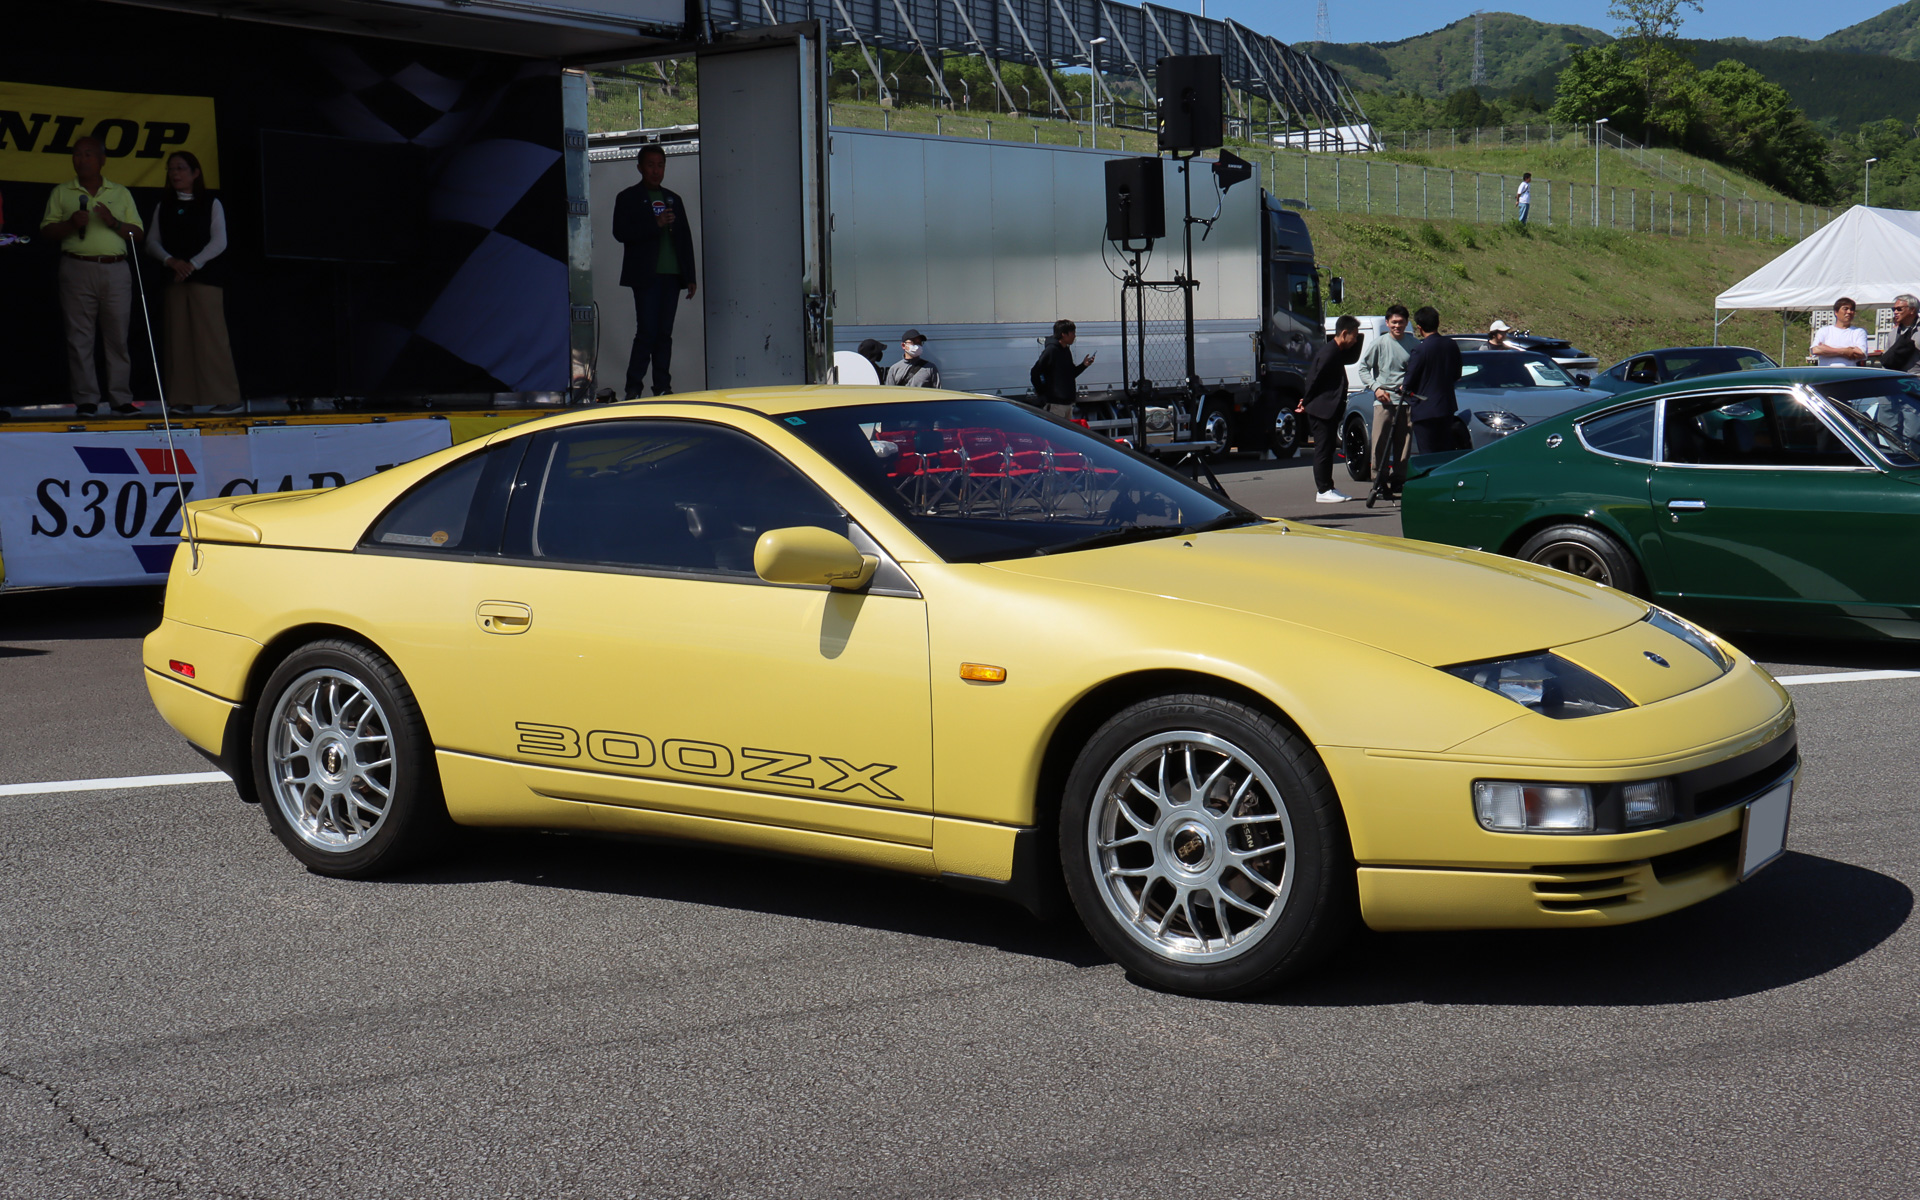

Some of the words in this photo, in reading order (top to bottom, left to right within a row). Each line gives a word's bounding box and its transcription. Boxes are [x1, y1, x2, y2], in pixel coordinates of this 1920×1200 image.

[0, 110, 190, 158] NLOP
[31, 478, 194, 539] S30Z
[514, 721, 905, 802] 300ZX
[1177, 835, 1203, 859] BBS
[1241, 823, 1255, 849] SSAN
